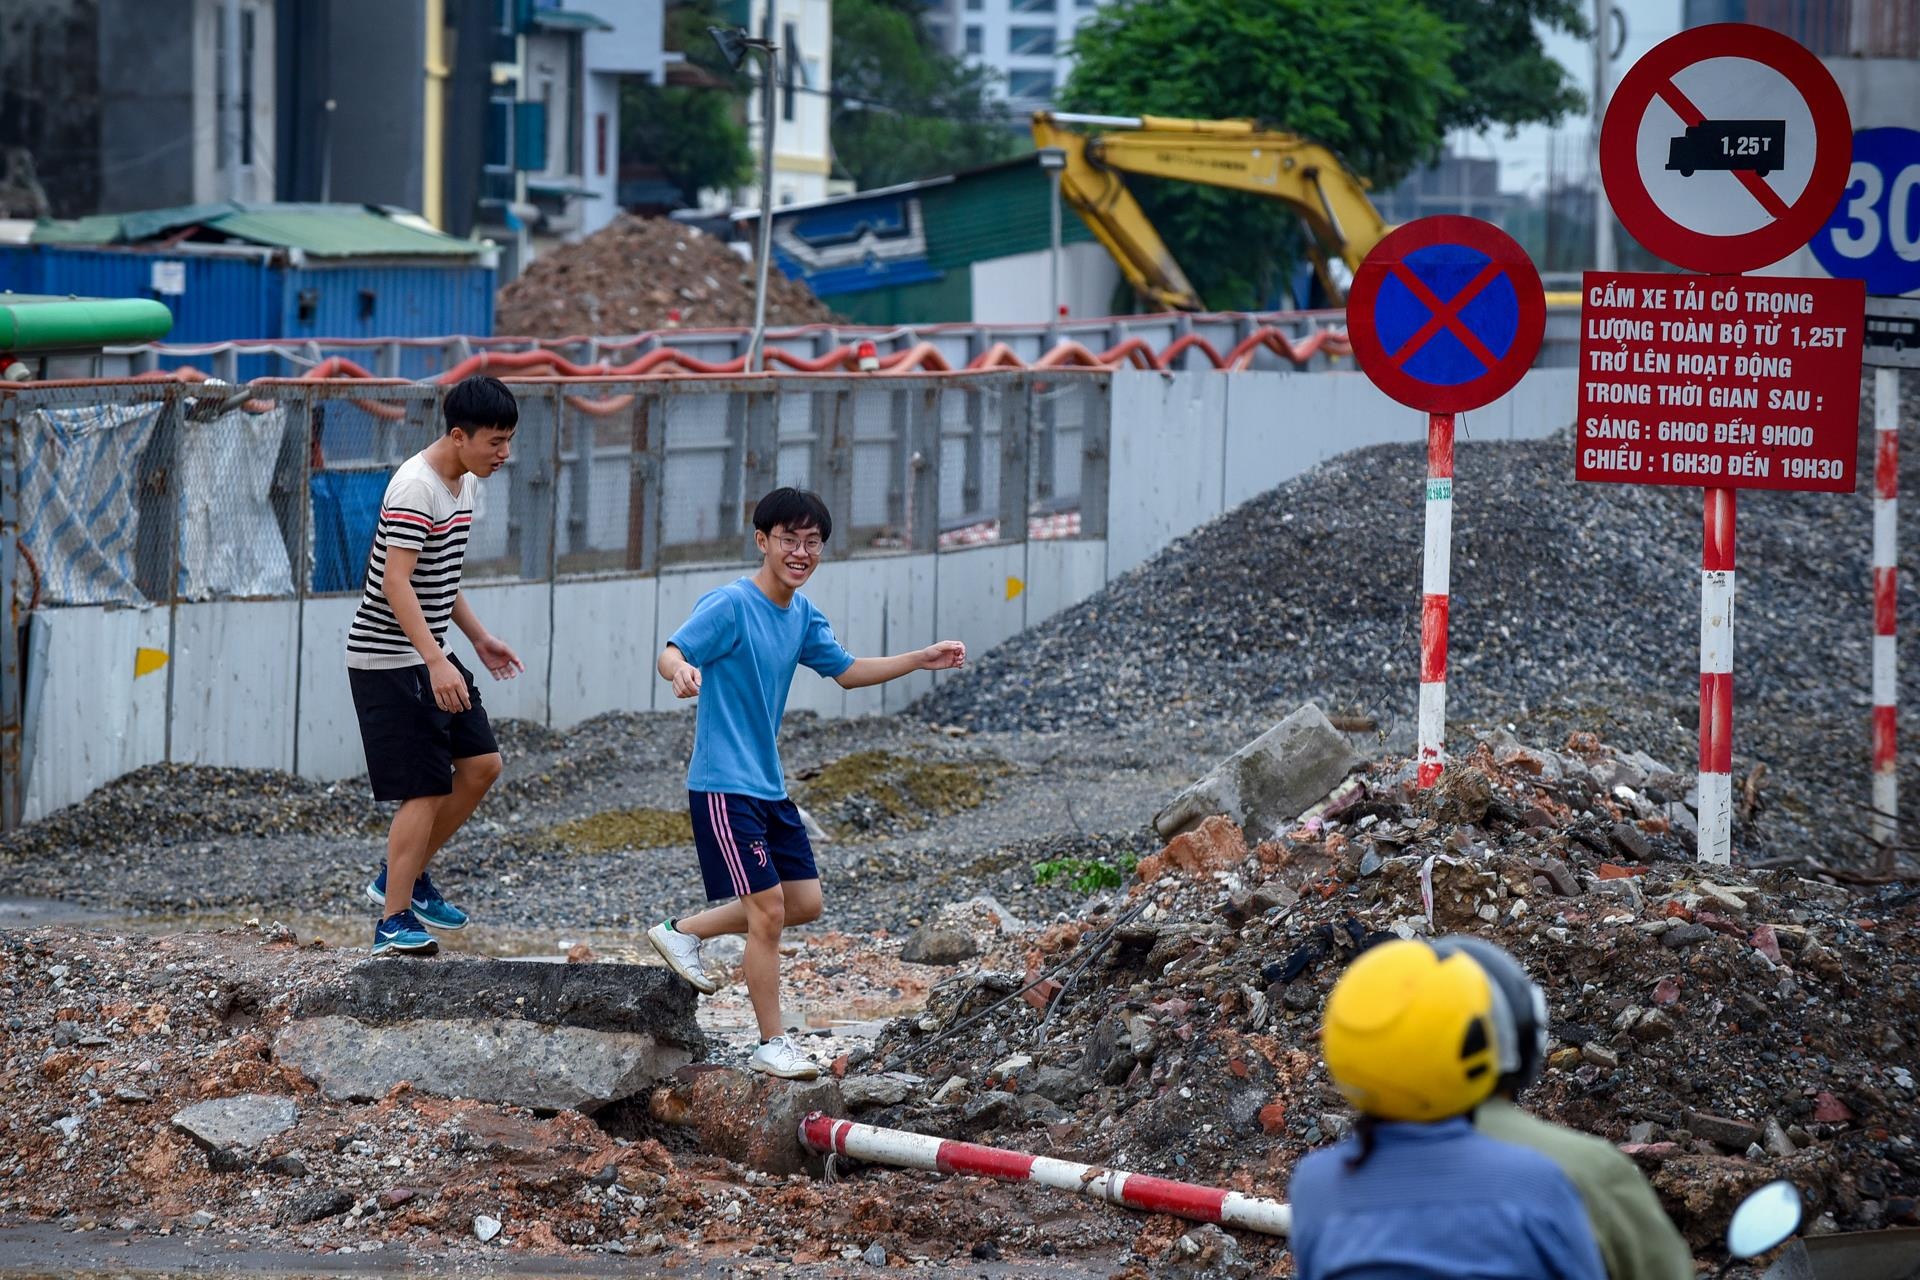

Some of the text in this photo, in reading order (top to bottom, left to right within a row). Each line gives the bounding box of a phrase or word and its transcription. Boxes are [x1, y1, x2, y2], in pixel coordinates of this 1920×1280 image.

[1720, 136, 1772, 156] 1,25T
[1590, 281, 1813, 318] CẤM XE TẢI CÓ TRỌNG
[1589, 318, 1846, 348] LƯỢNG TOÀN BỘ TỪ 1,25T
[1590, 344, 1791, 382] TRỞ LÊN HOẠT ĐỘNG
[1586, 381, 1822, 411] TRONG THỜI GIAN SAU :
[1586, 414, 1813, 446] SÁNG : 6H00 ĐẾN 9H00
[1584, 442, 1843, 479] CHIỀU : 16H30 ĐẾN 19H30
